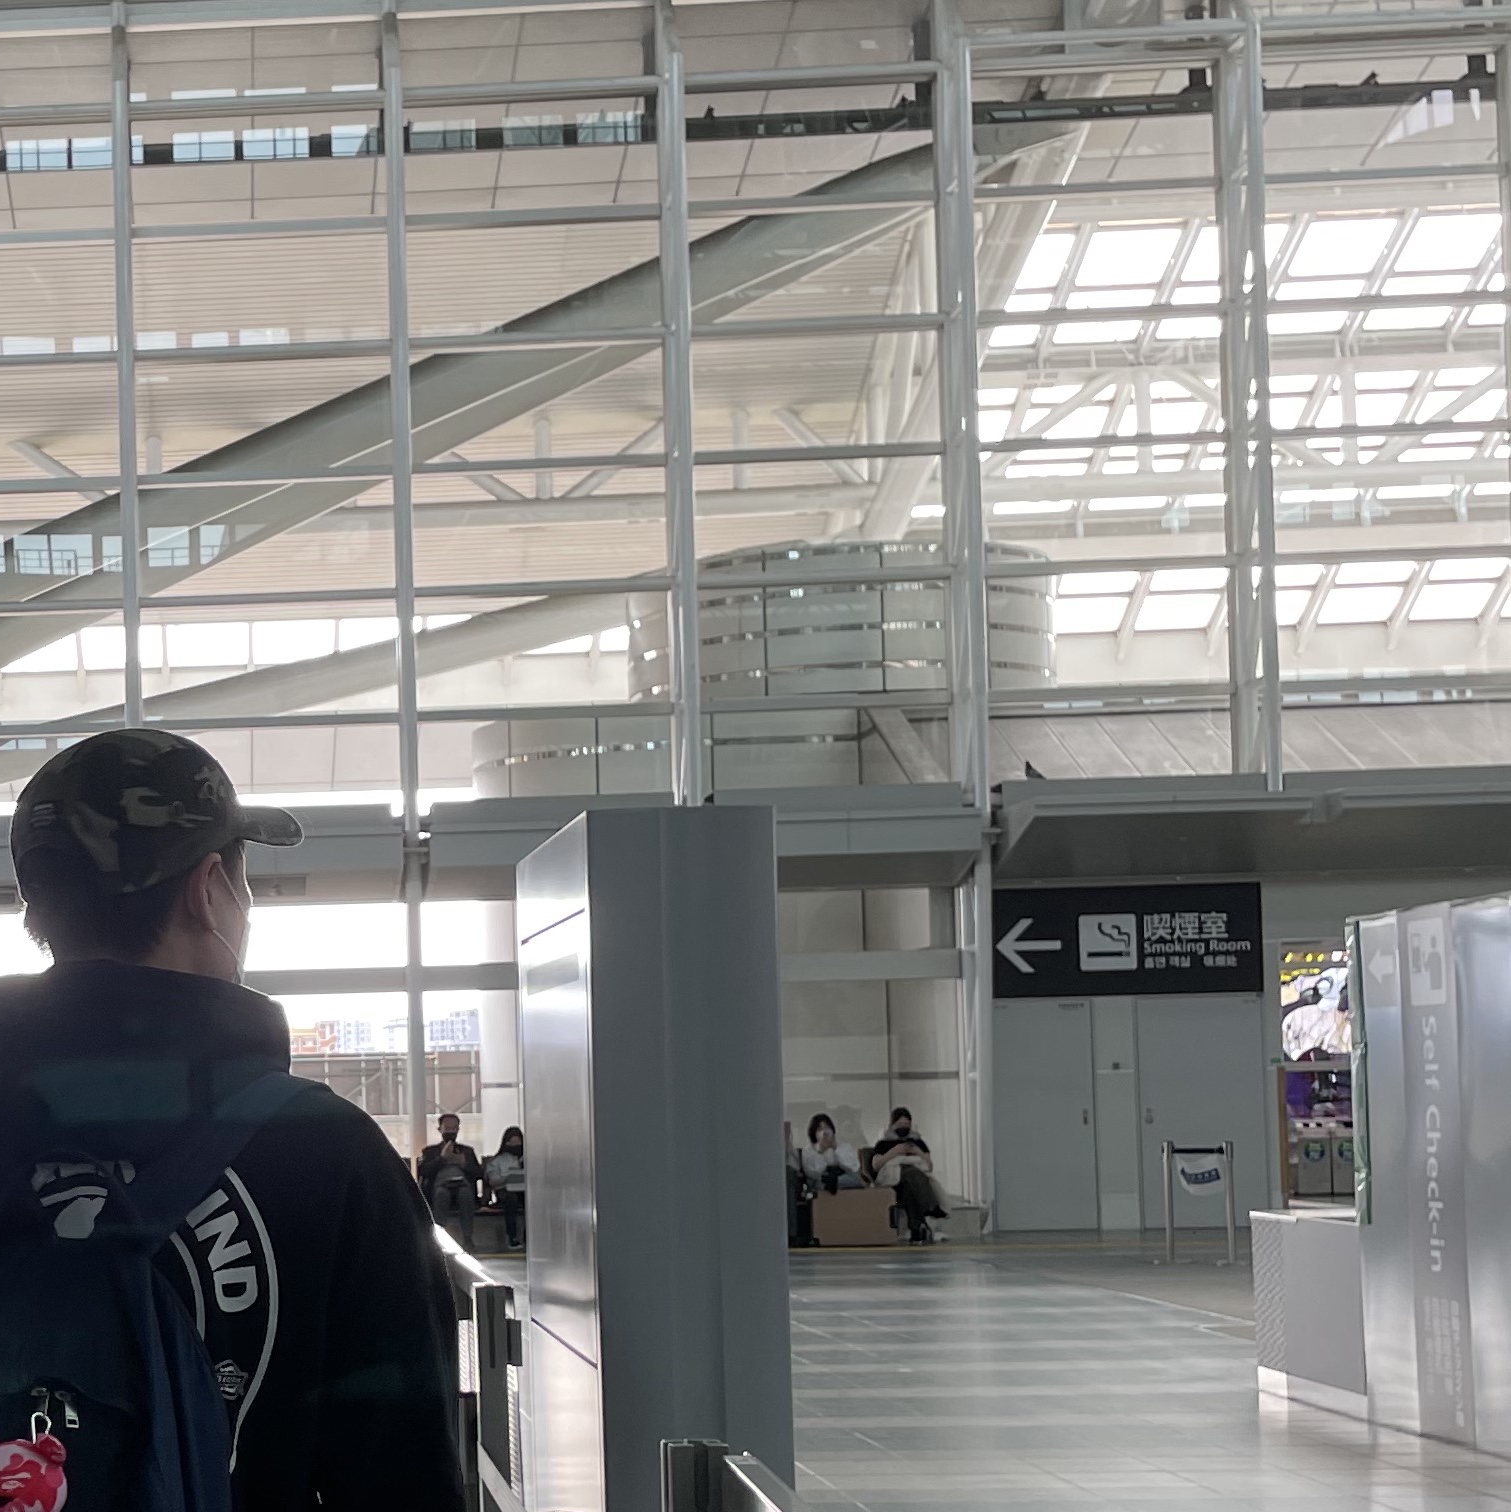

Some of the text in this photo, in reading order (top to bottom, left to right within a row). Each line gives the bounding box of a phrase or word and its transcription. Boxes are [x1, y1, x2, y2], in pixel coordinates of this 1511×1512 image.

[1143, 911, 1229, 941] 喫煙室
[1143, 939, 1251, 955] Smoking Room
[1421, 1015, 1440, 1091] Self
[1425, 1104, 1445, 1273] Check-in
